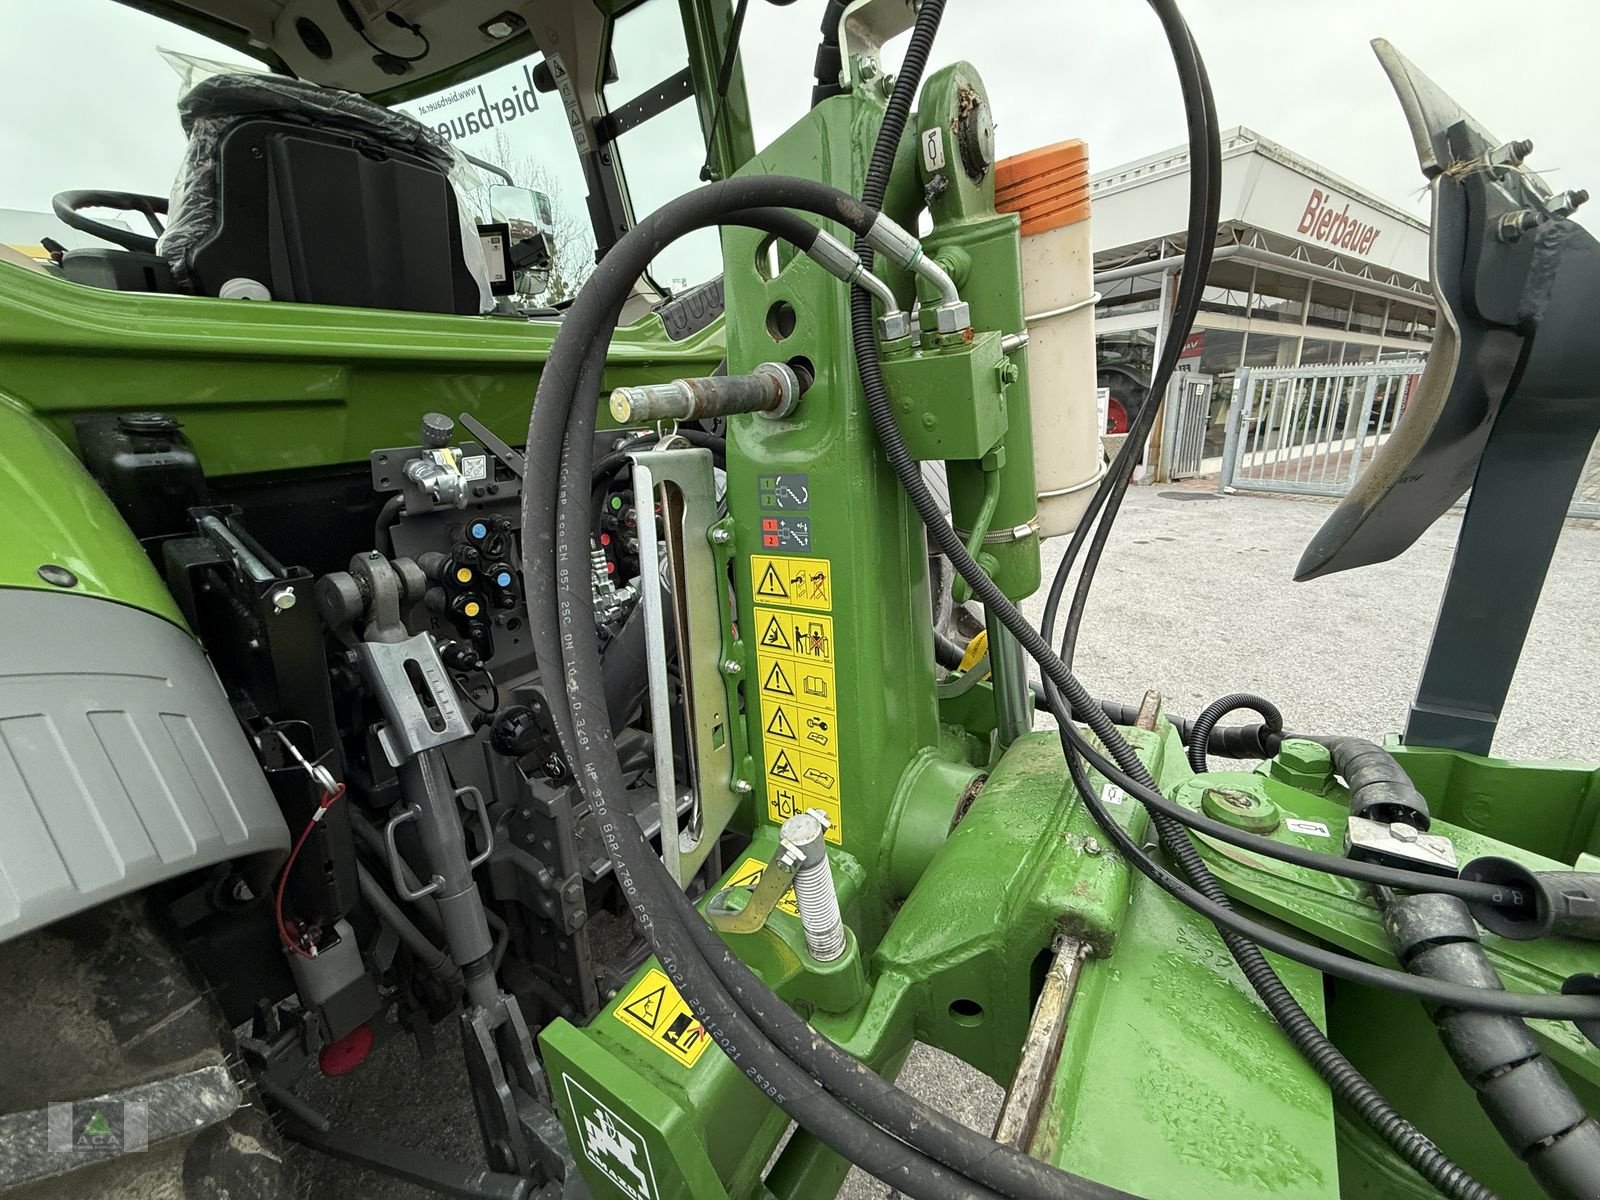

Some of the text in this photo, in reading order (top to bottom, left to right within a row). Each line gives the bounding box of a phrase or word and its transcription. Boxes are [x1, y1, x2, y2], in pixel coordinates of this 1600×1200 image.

[1297, 188, 1381, 256] Bierbauer
[560, 569, 569, 592] 857
[561, 601, 572, 625] 2SC
[563, 633, 574, 650] DN
[585, 762, 599, 781] WP
[592, 788, 607, 816] 330
[603, 823, 637, 895] BAR/4780
[634, 903, 654, 930] PSI
[689, 998, 742, 1061] 29112021
[745, 1066, 786, 1104] 25385
